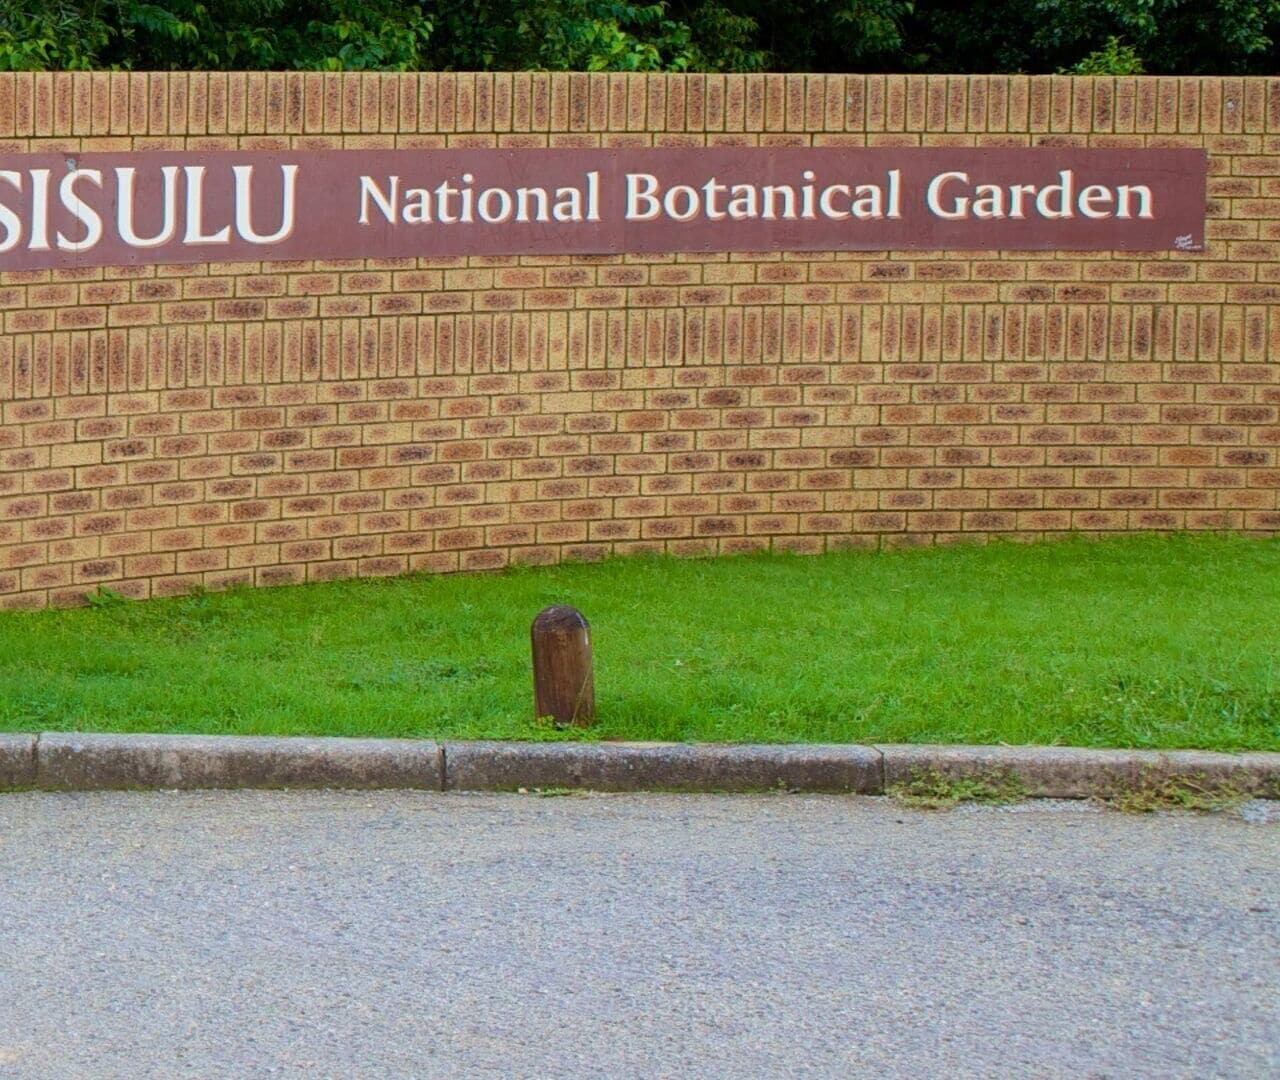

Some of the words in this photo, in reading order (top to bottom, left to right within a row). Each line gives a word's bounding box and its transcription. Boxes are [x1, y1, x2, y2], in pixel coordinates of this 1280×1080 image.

[357, 171, 602, 225] National
[624, 170, 902, 221] Botanical
[926, 170, 1155, 219] Garden
